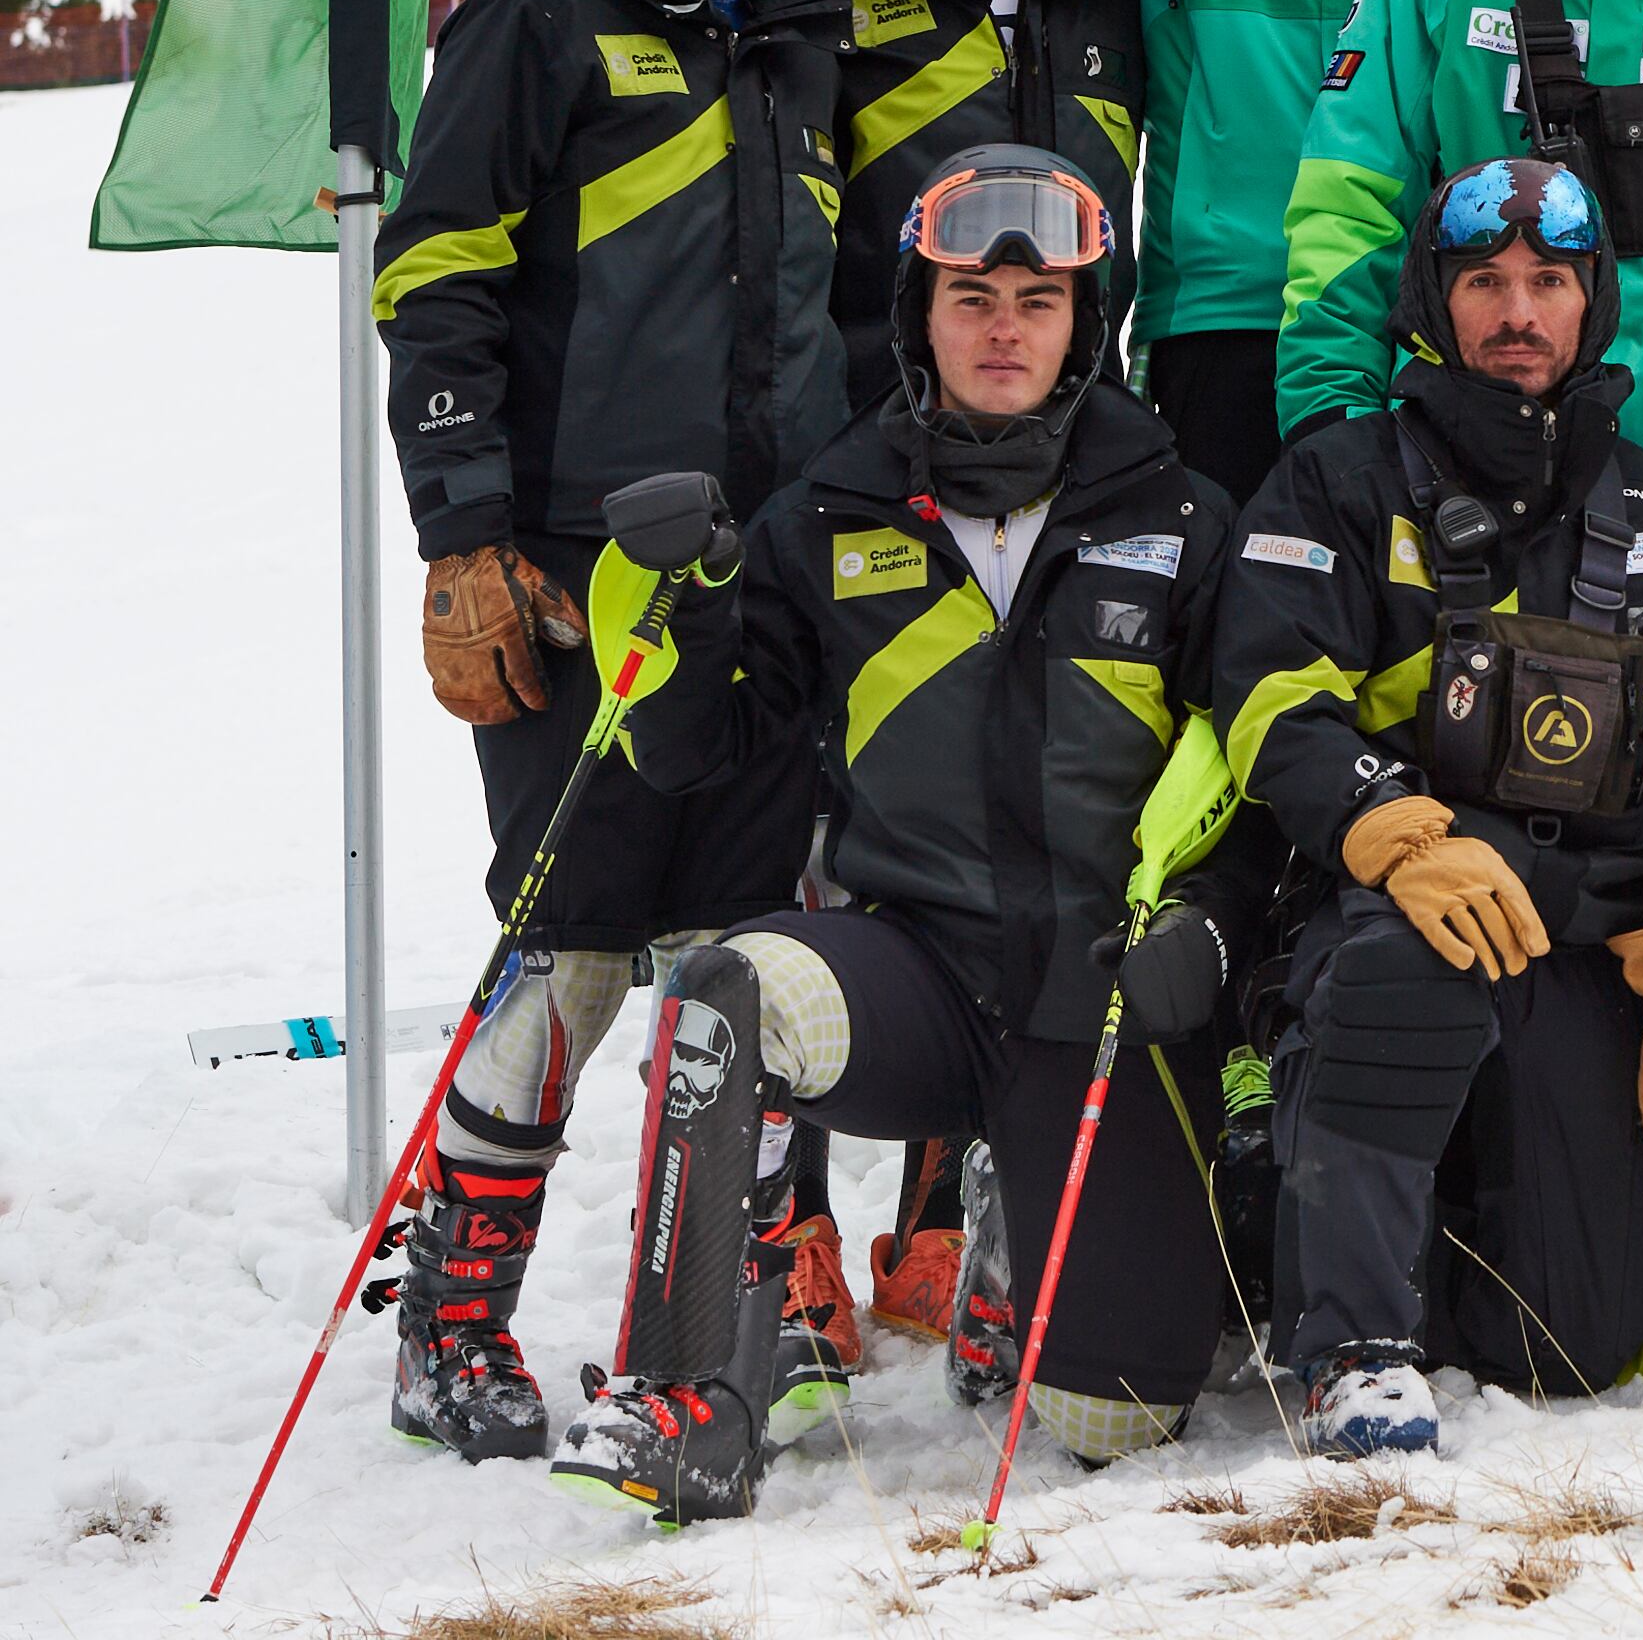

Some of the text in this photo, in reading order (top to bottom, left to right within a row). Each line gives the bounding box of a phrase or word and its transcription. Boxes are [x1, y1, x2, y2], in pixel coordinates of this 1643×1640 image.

[876, 4, 926, 25] Andorrà
[632, 52, 667, 66] Crèdit
[636, 61, 680, 77] Andorrà
[869, 544, 910, 562] Crèdit
[1250, 537, 1304, 558] caldea
[870, 555, 922, 575] Andorrà
[1200, 780, 1236, 838] EKI
[650, 1145, 681, 1275] ENERGIAPURA
